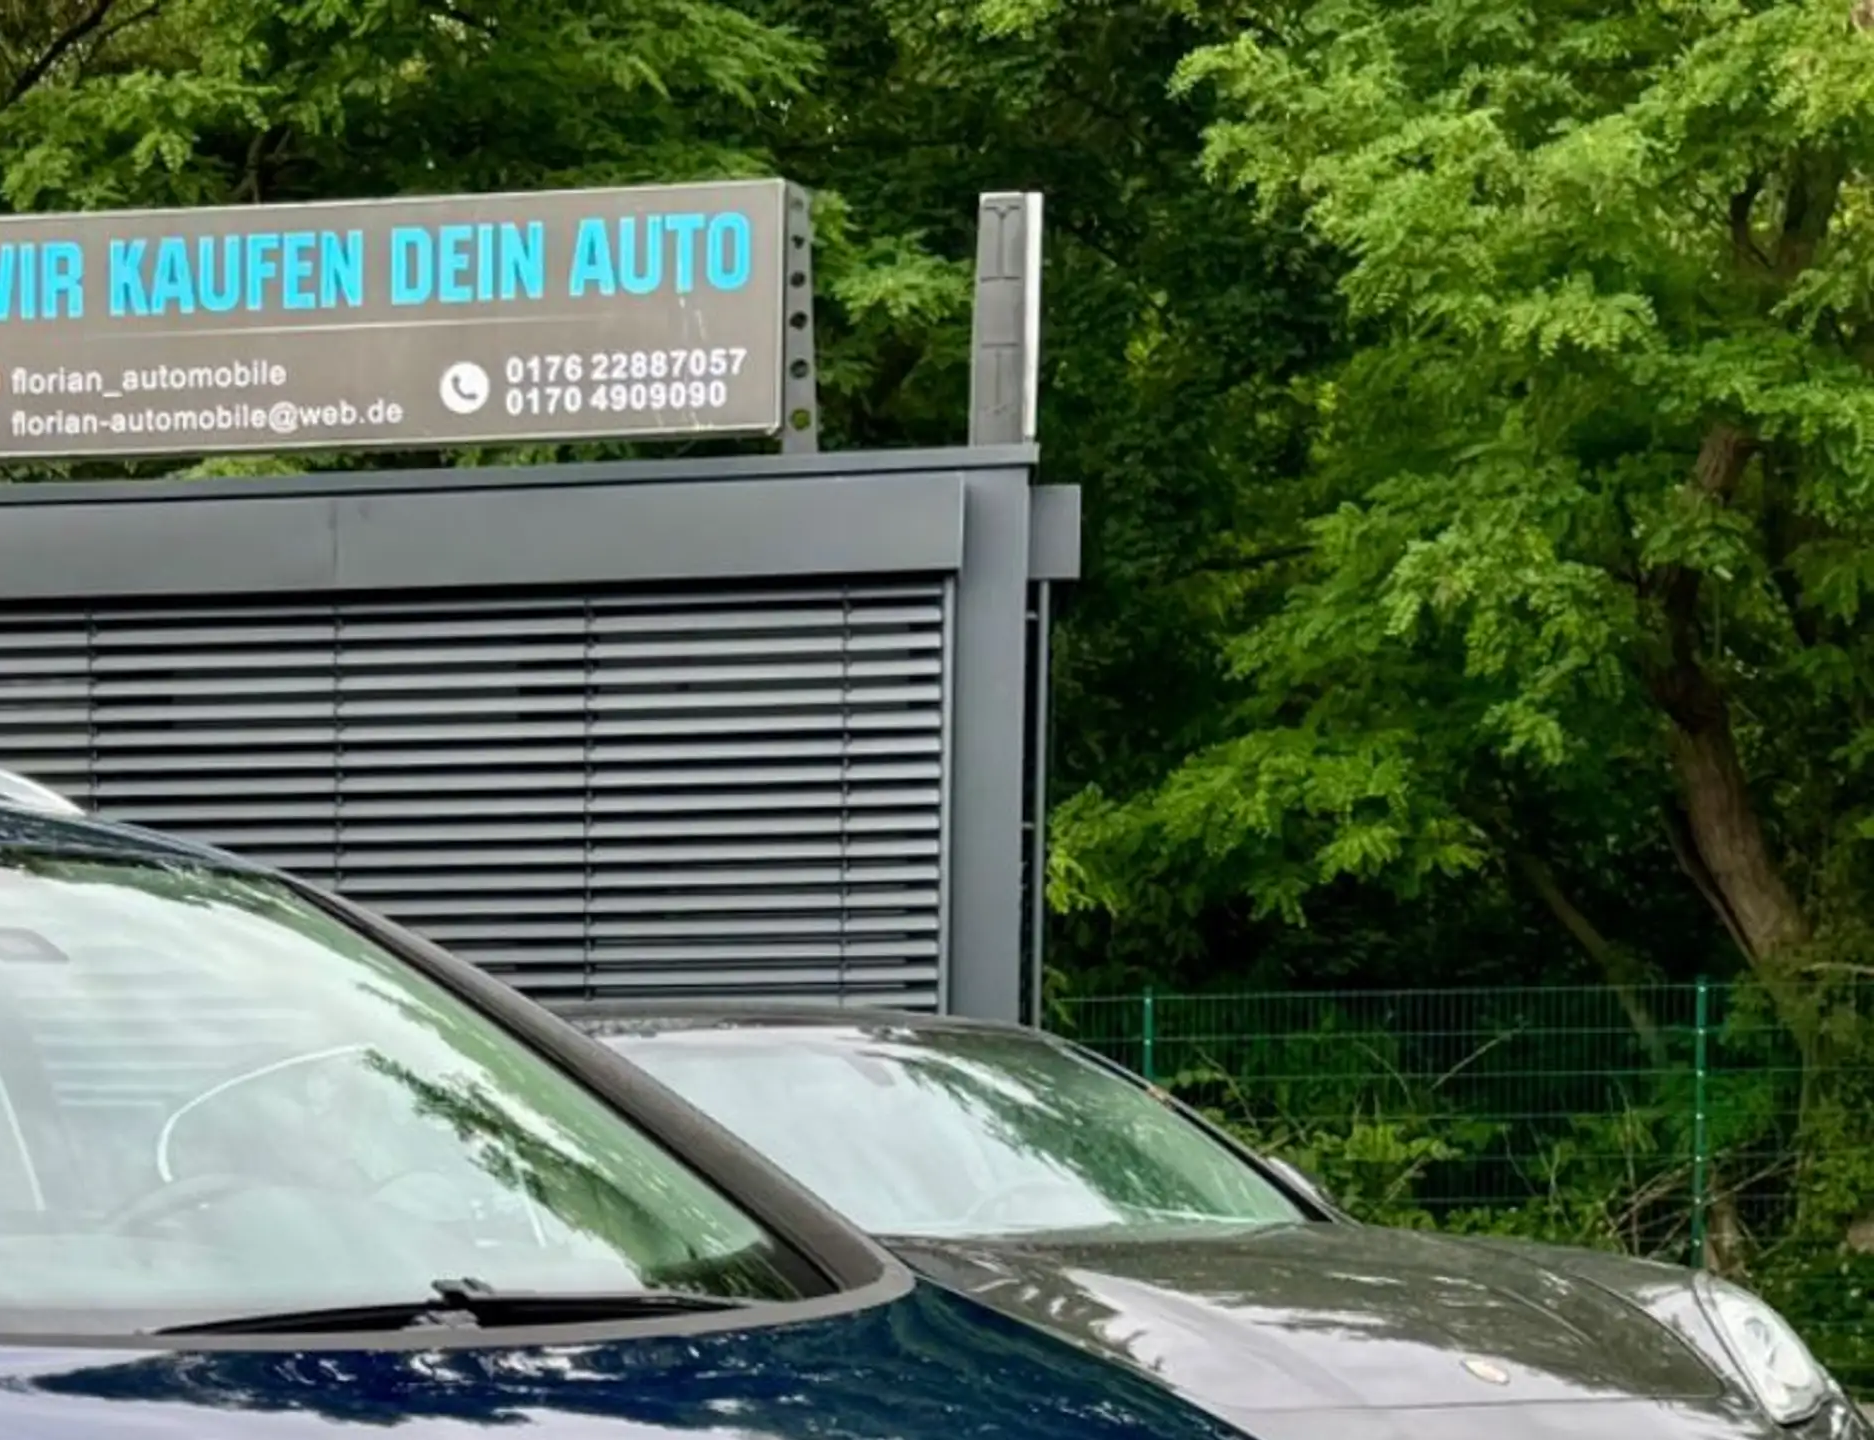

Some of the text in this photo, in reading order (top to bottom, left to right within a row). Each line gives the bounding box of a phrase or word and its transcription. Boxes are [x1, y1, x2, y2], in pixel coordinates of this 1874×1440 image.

[109, 229, 363, 317] KAUFEN
[391, 221, 544, 305] DEIN
[569, 211, 751, 296] AUTO
[11, 361, 287, 398] florian_automobile
[505, 348, 747, 384] 0176 22887057
[505, 380, 727, 415] 0170 4909090
[11, 398, 404, 436] florian-automobile@web.de
